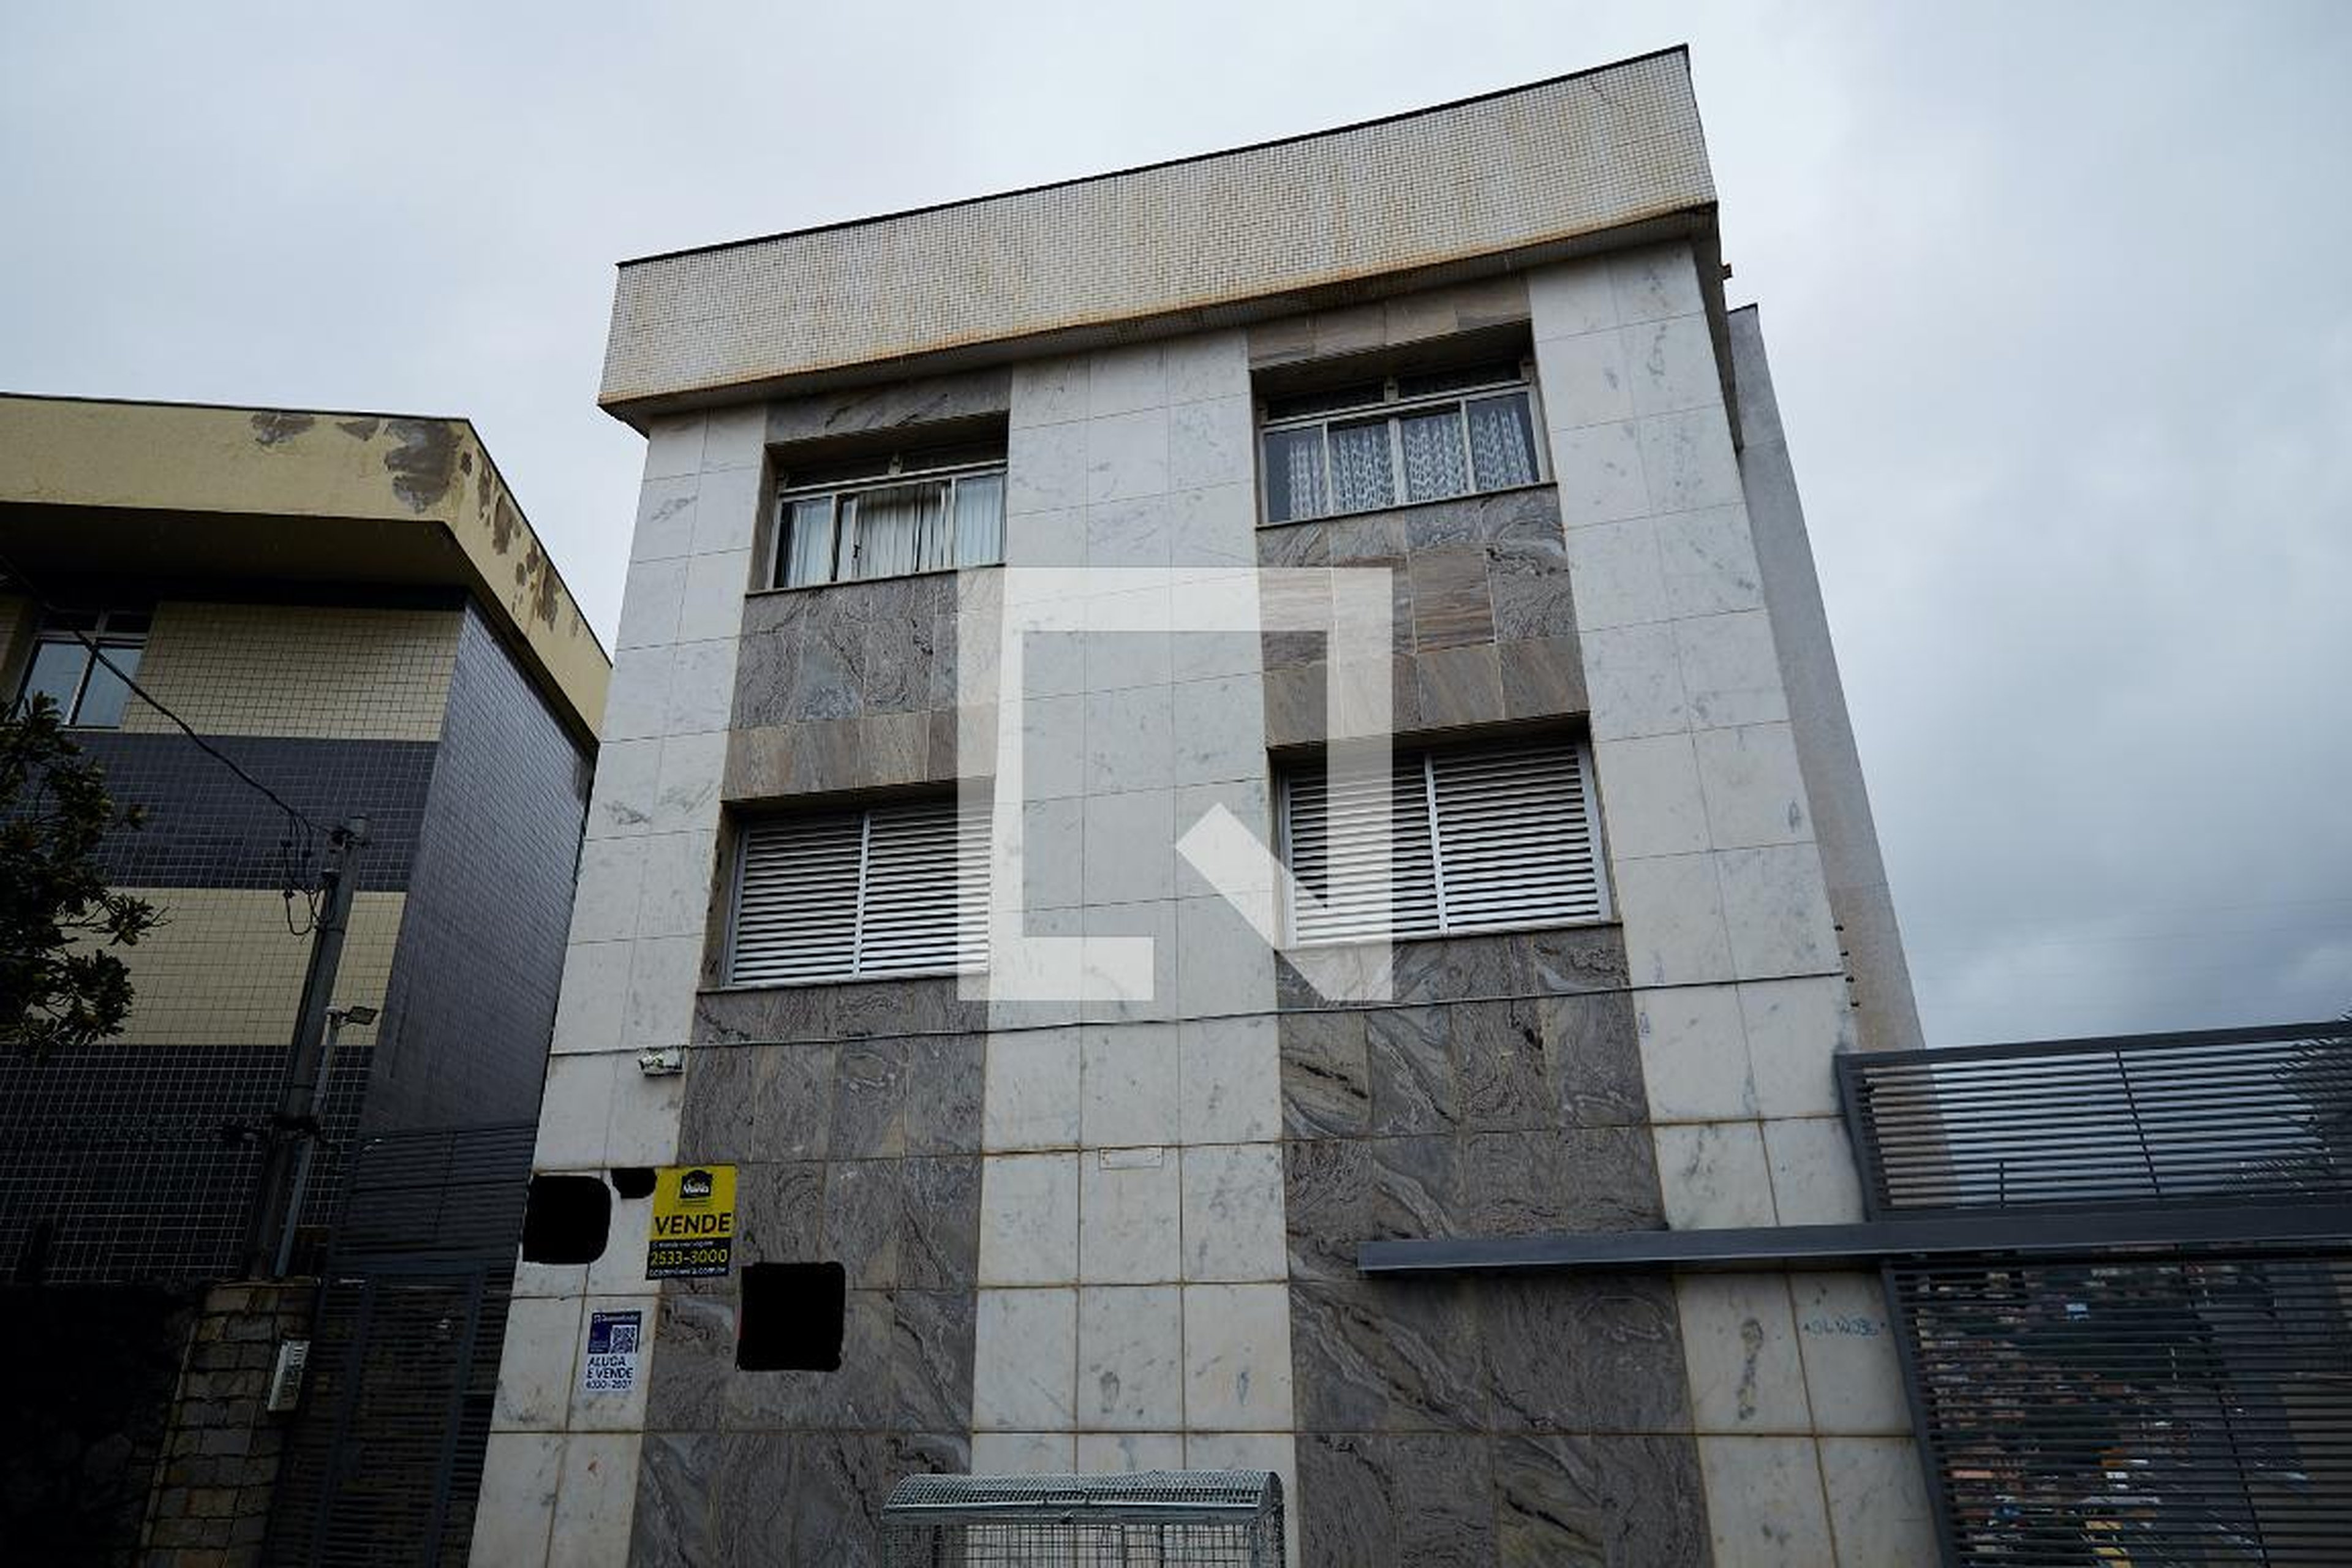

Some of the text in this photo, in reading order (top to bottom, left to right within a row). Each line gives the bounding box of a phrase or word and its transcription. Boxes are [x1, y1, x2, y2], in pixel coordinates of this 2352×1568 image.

[654, 1213, 731, 1235] VENDE
[650, 1249, 728, 1265] 2533-3000
[588, 1355, 627, 1366] ALUGA
[587, 1367, 633, 1379] E VENDE
